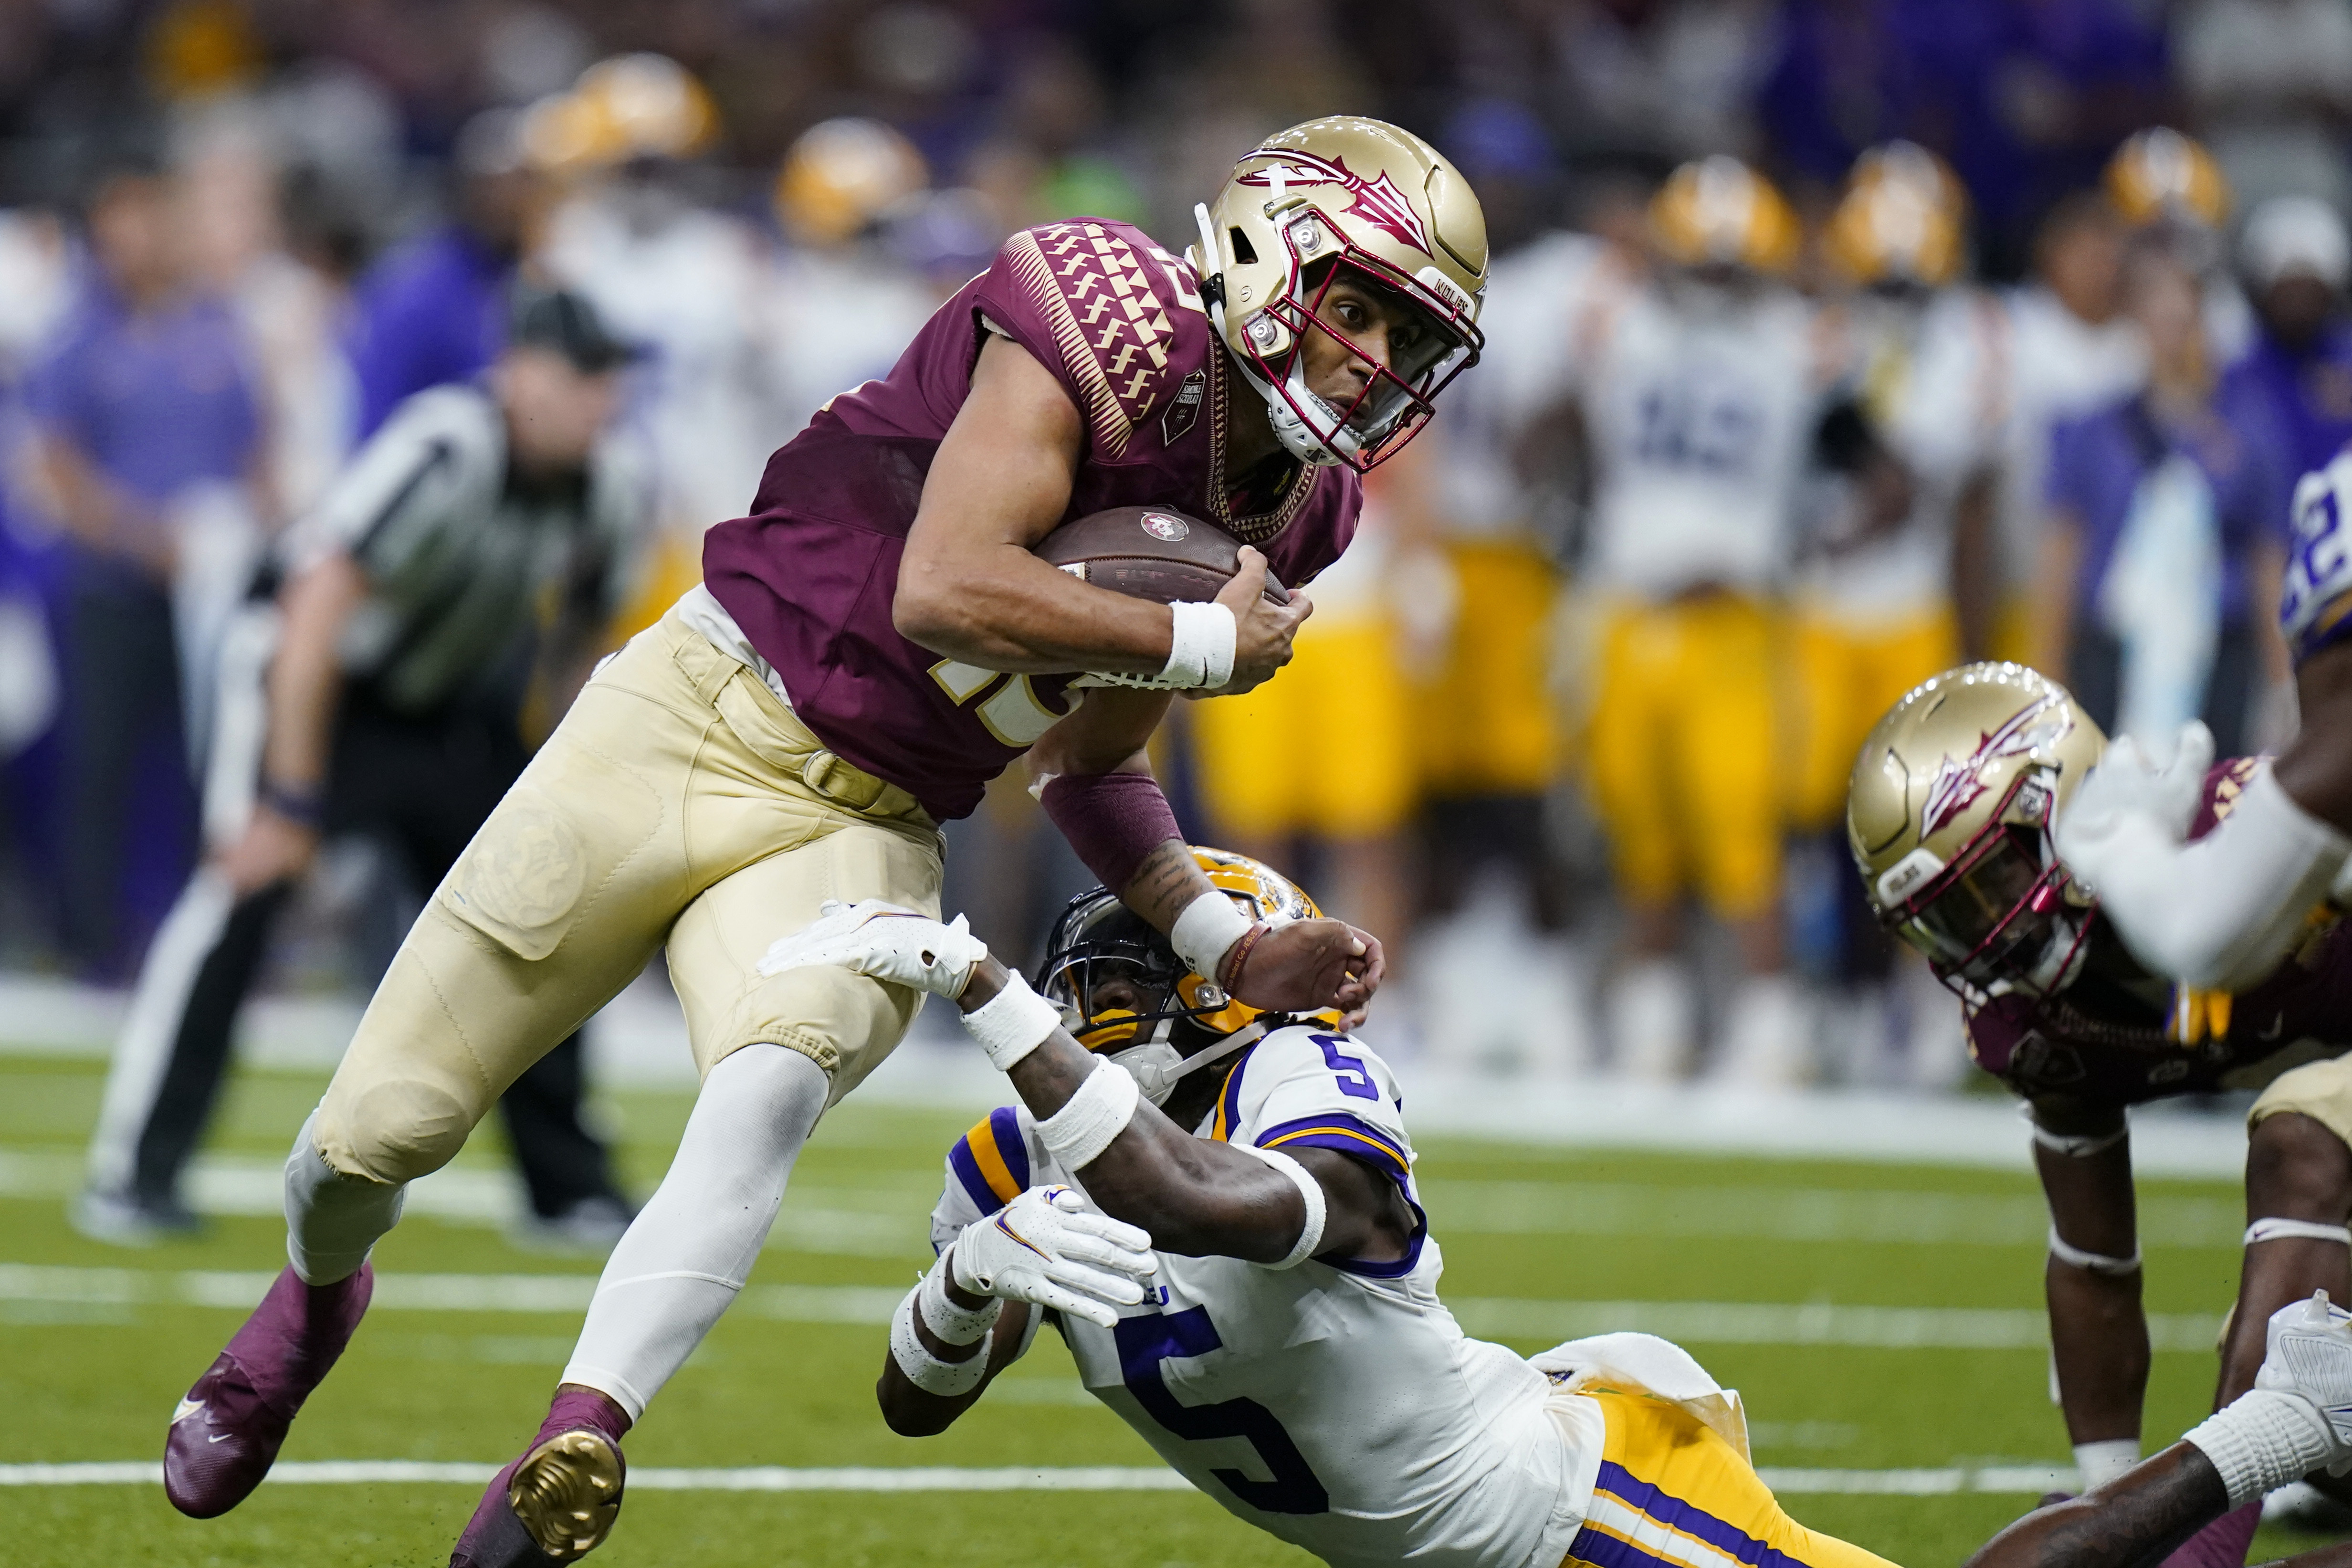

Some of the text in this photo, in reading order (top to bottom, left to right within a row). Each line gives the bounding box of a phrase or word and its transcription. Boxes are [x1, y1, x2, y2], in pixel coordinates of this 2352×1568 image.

[1434, 278, 1468, 314] NOLES
[1237, 950, 1245, 959] Go
[1243, 931, 1258, 950] JESUS
[1307, 1034, 1379, 1102] 5
[1113, 1304, 1329, 1515] 5
